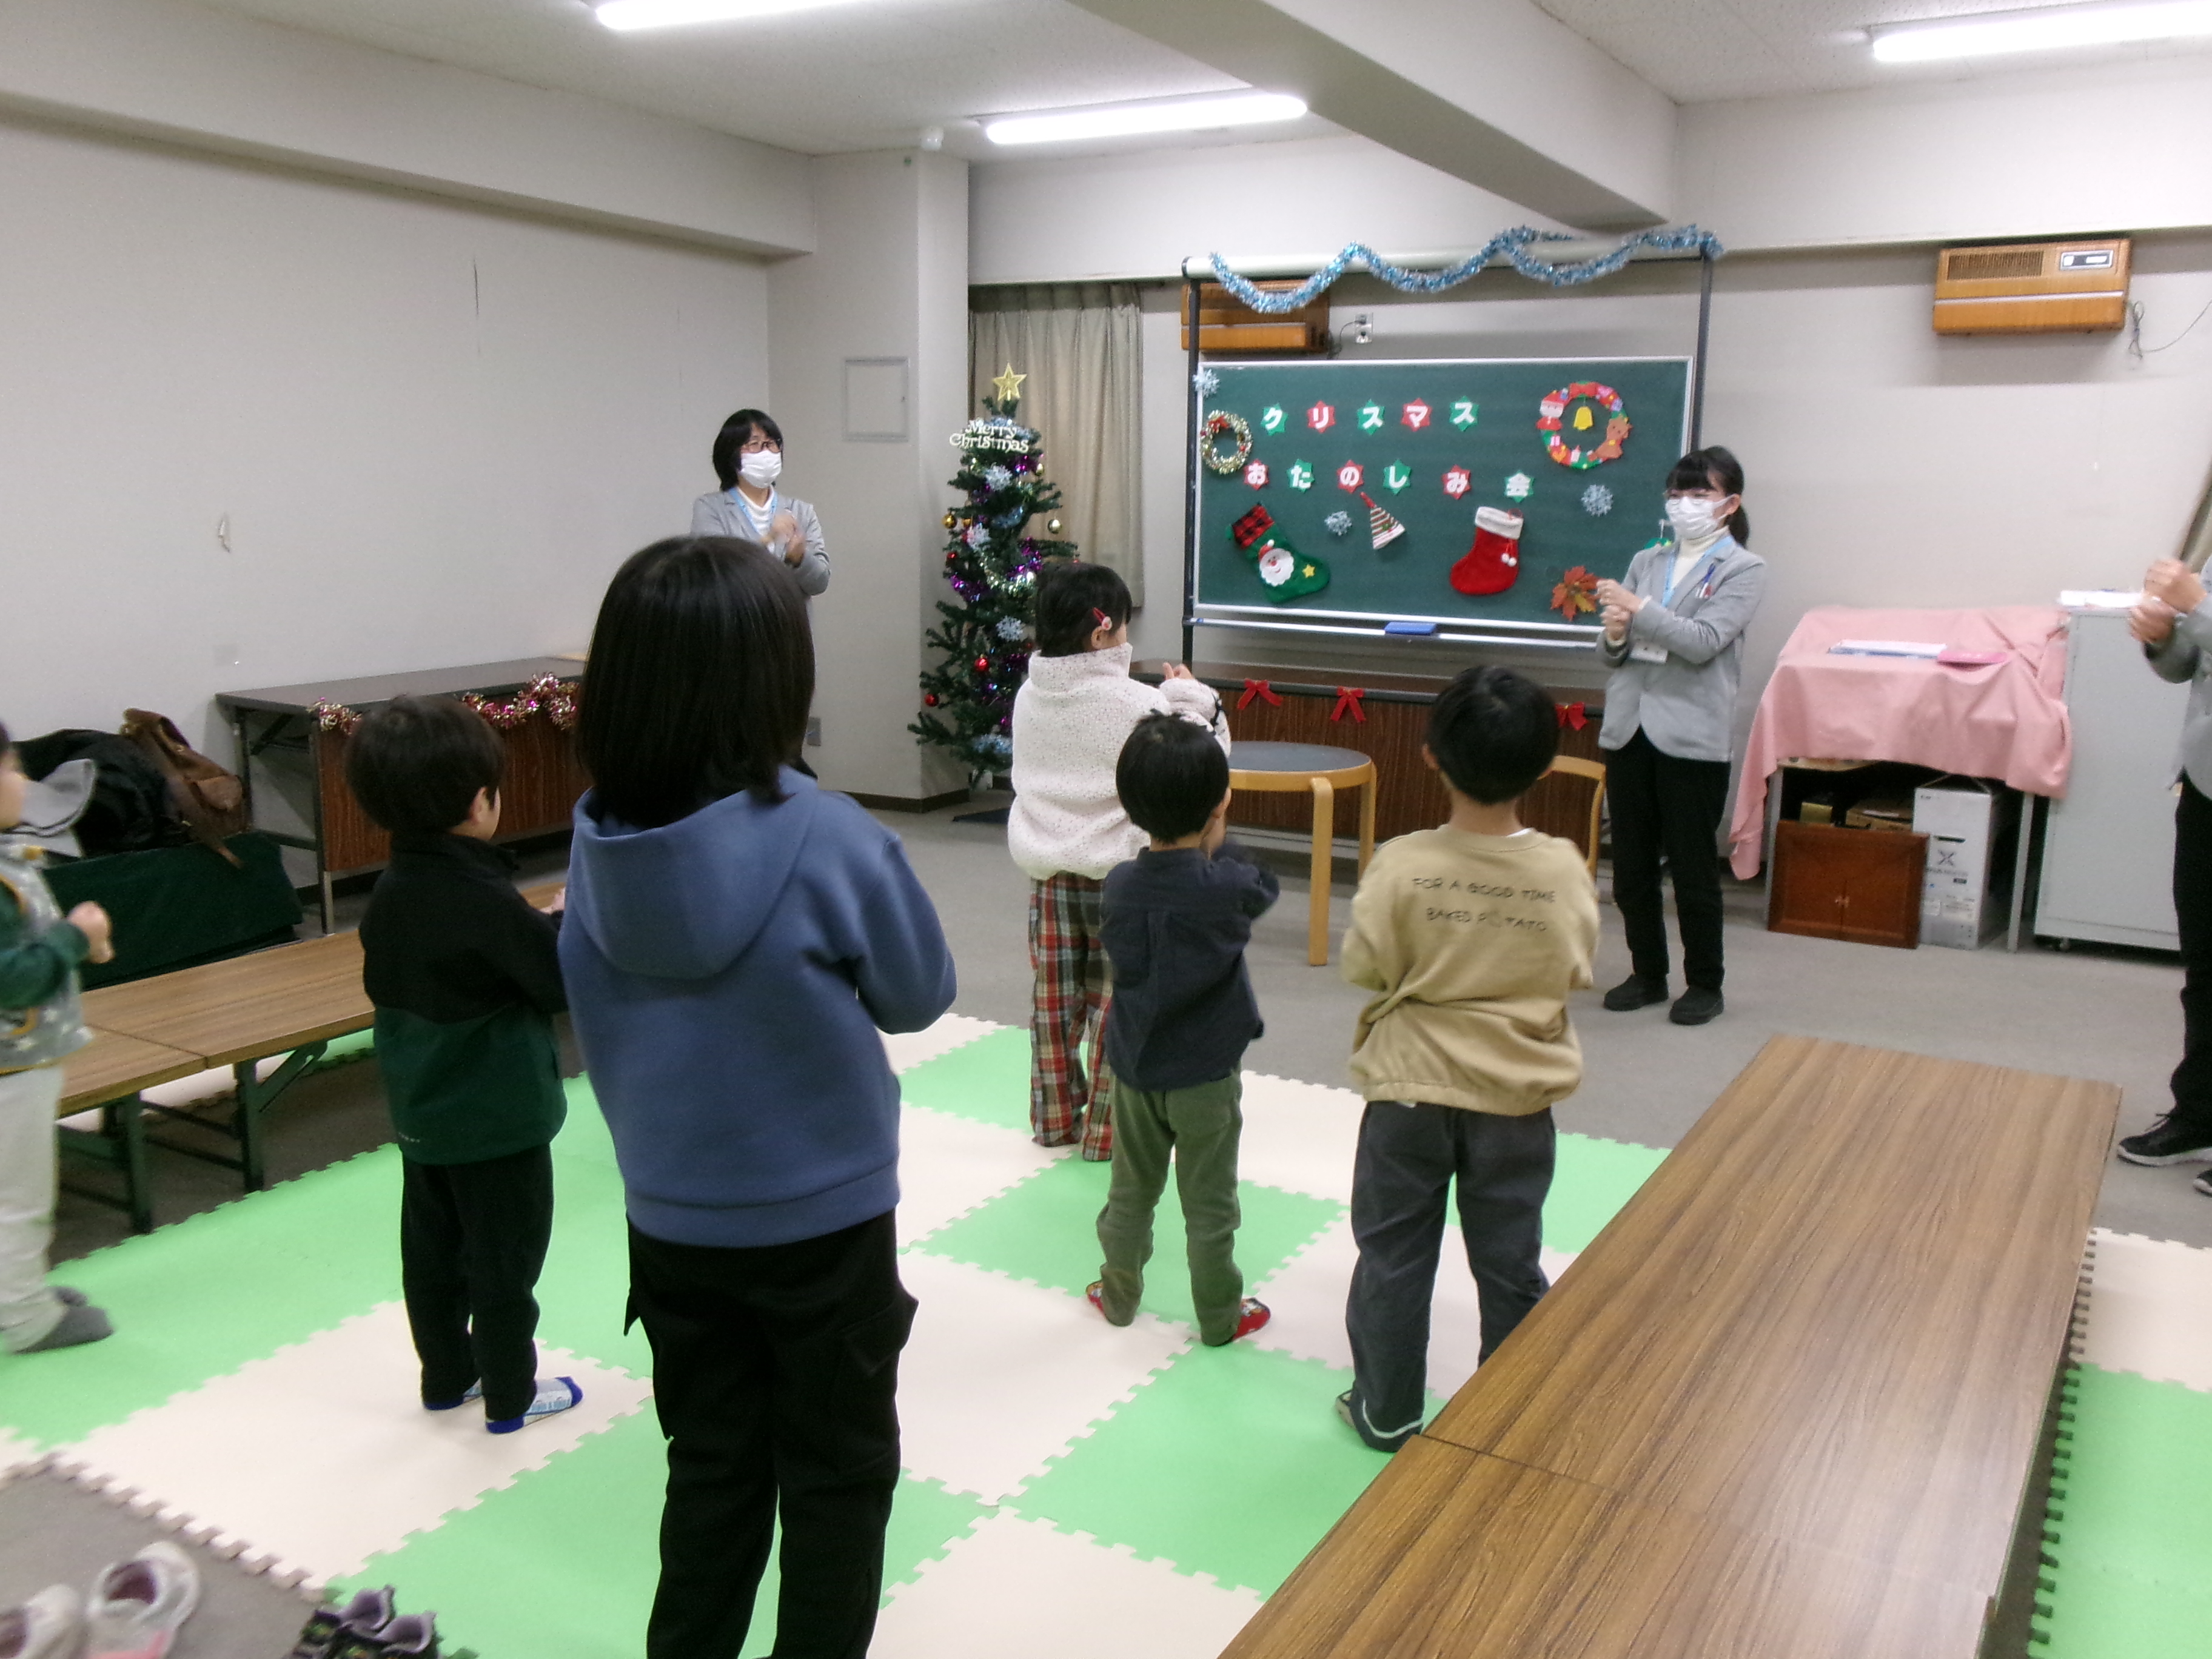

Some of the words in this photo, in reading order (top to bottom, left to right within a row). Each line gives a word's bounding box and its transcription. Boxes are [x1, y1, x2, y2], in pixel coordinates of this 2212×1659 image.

[1264, 401, 1475, 430] クリスマス
[965, 420, 1017, 439] Merry
[949, 432, 1030, 454] Christmas
[1412, 877, 1443, 889] FOR
[1449, 880, 1461, 891] A
[1467, 882, 1514, 899] GOOD
[1521, 889, 1556, 903] TIME
